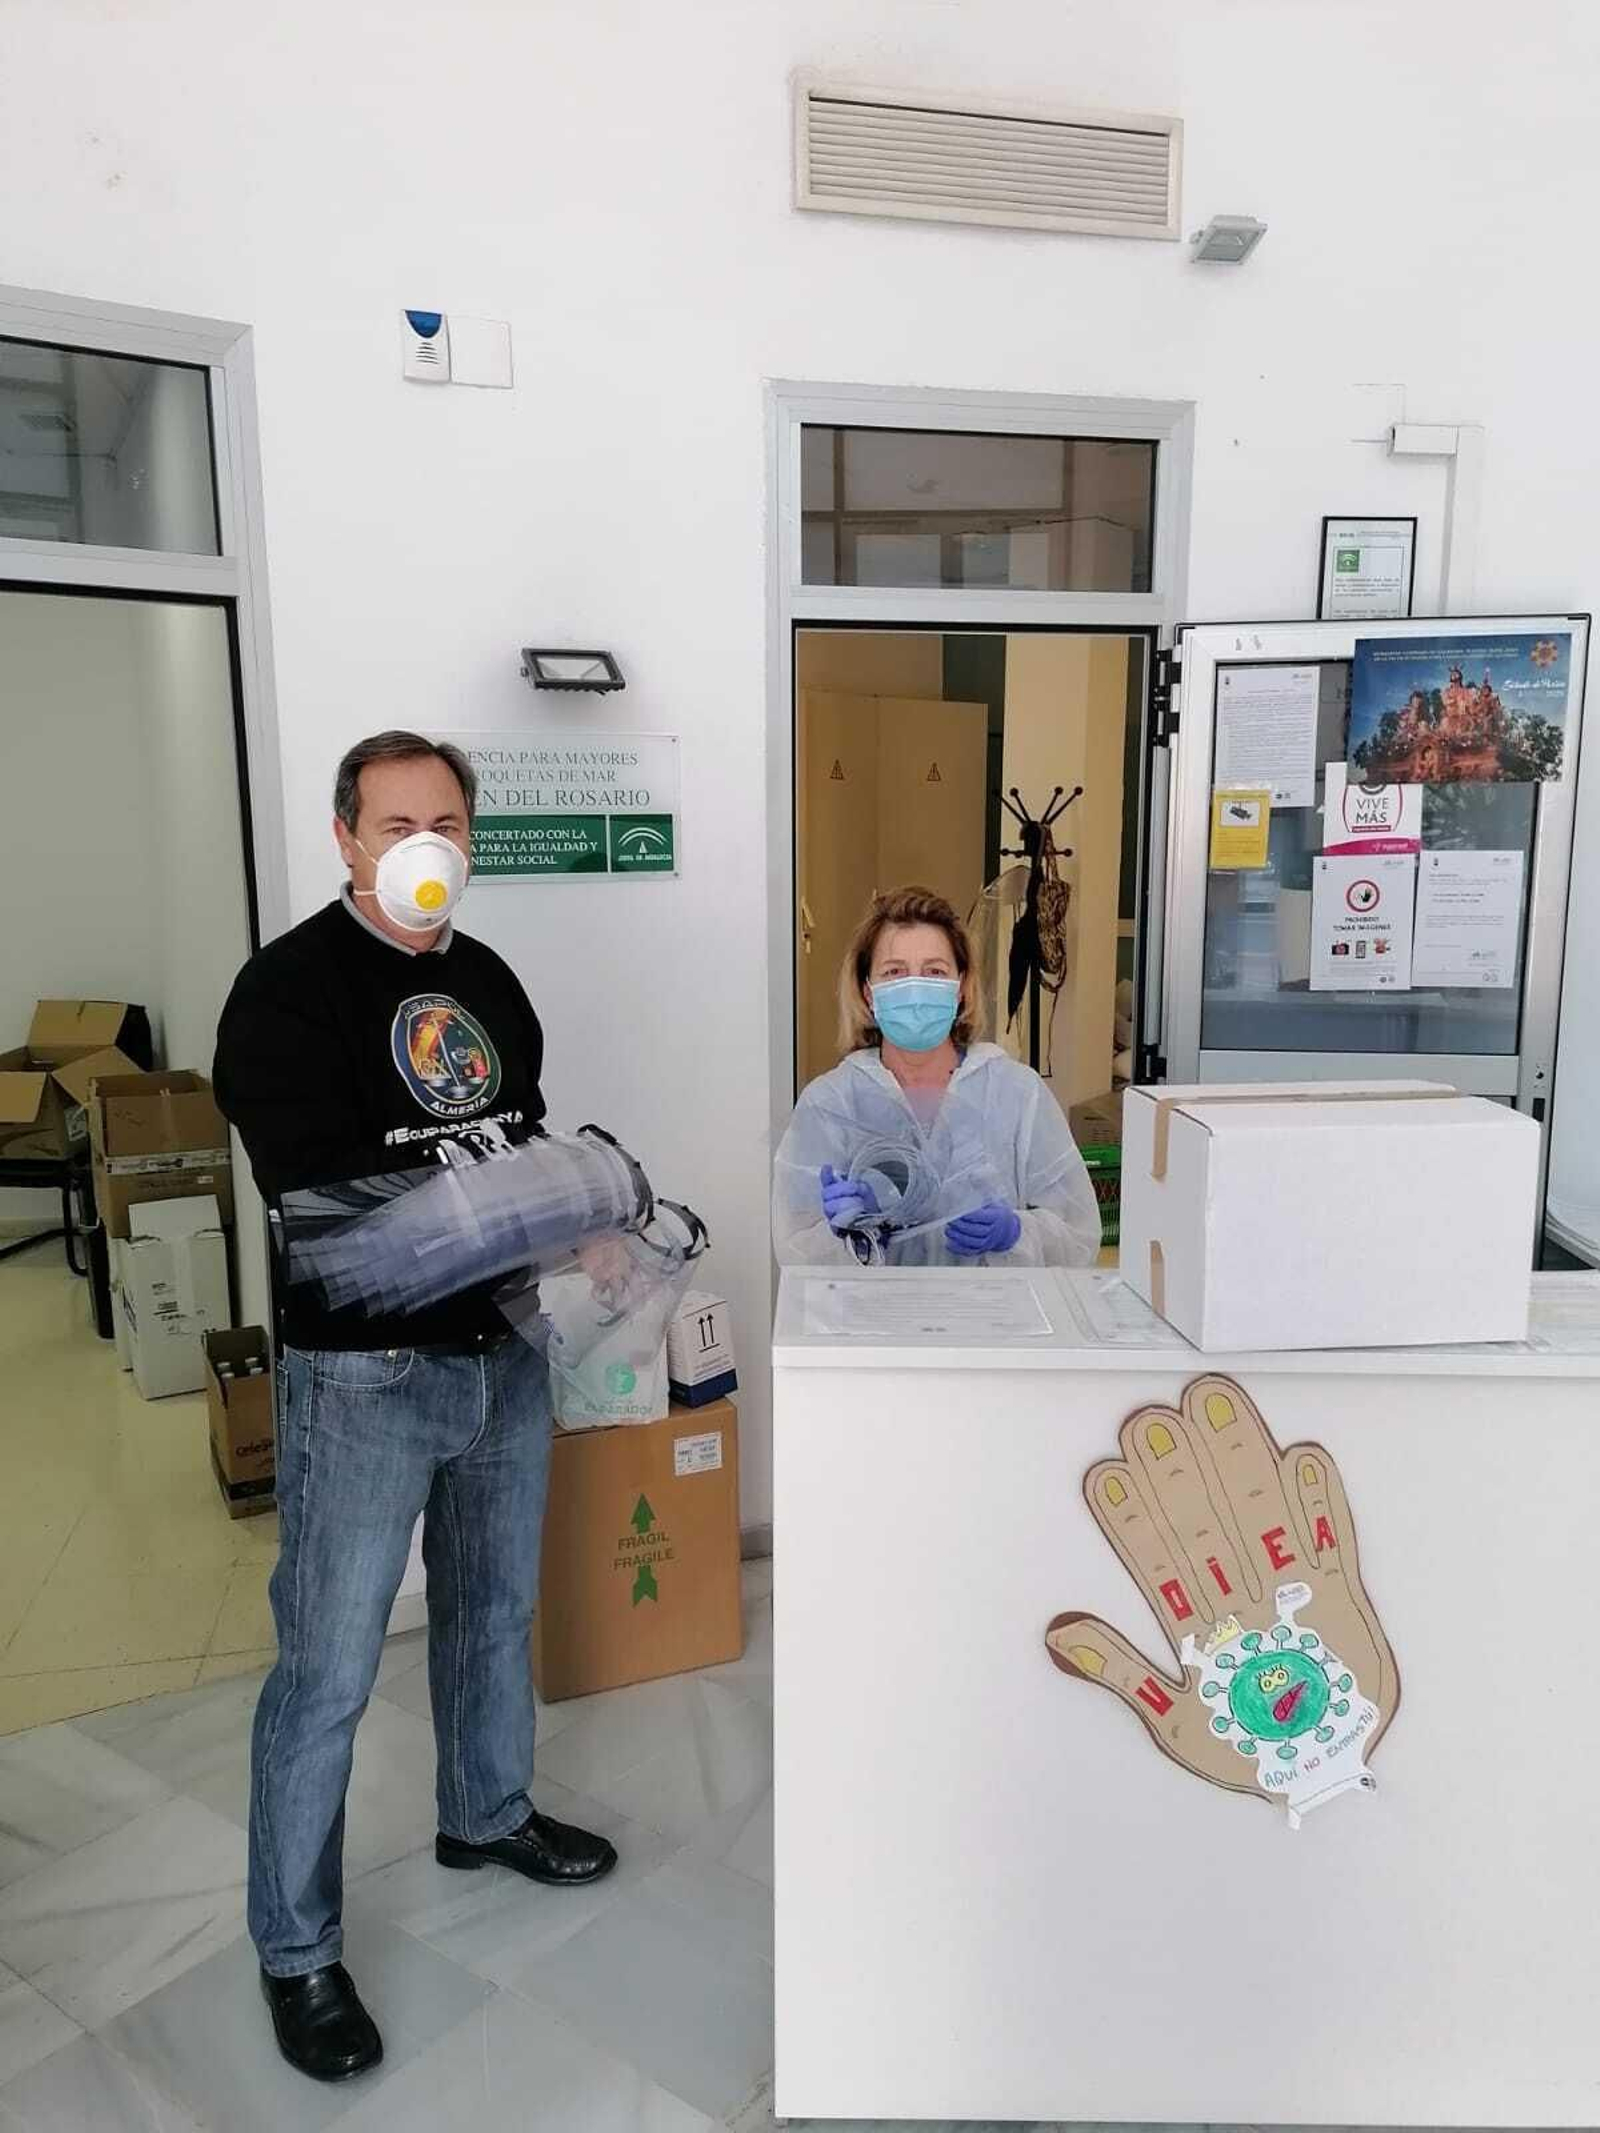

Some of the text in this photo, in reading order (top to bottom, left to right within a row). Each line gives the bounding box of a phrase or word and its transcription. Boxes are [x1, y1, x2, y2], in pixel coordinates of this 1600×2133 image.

[520, 752, 560, 764] PARA
[565, 752, 638, 765] MAYORES
[560, 769, 578, 781] DE
[583, 769, 616, 781] MAR
[506, 789, 549, 806] DEL
[555, 789, 650, 806] ROSARIO
[1356, 797, 1389, 811] VIVE
[1356, 810, 1388, 824] MÁS
[546, 829, 569, 840] CON
[572, 829, 587, 840] LA
[480, 842, 509, 853] PARA
[512, 842, 526, 853] LA
[530, 841, 588, 853] IGUALDAD
[590, 841, 598, 852] Y
[517, 855, 558, 865] SOCIAL
[618, 1532, 670, 1551] FRAGIL
[613, 1548, 675, 1572] FRAGILE
[1304, 1757, 1321, 1773] NO
